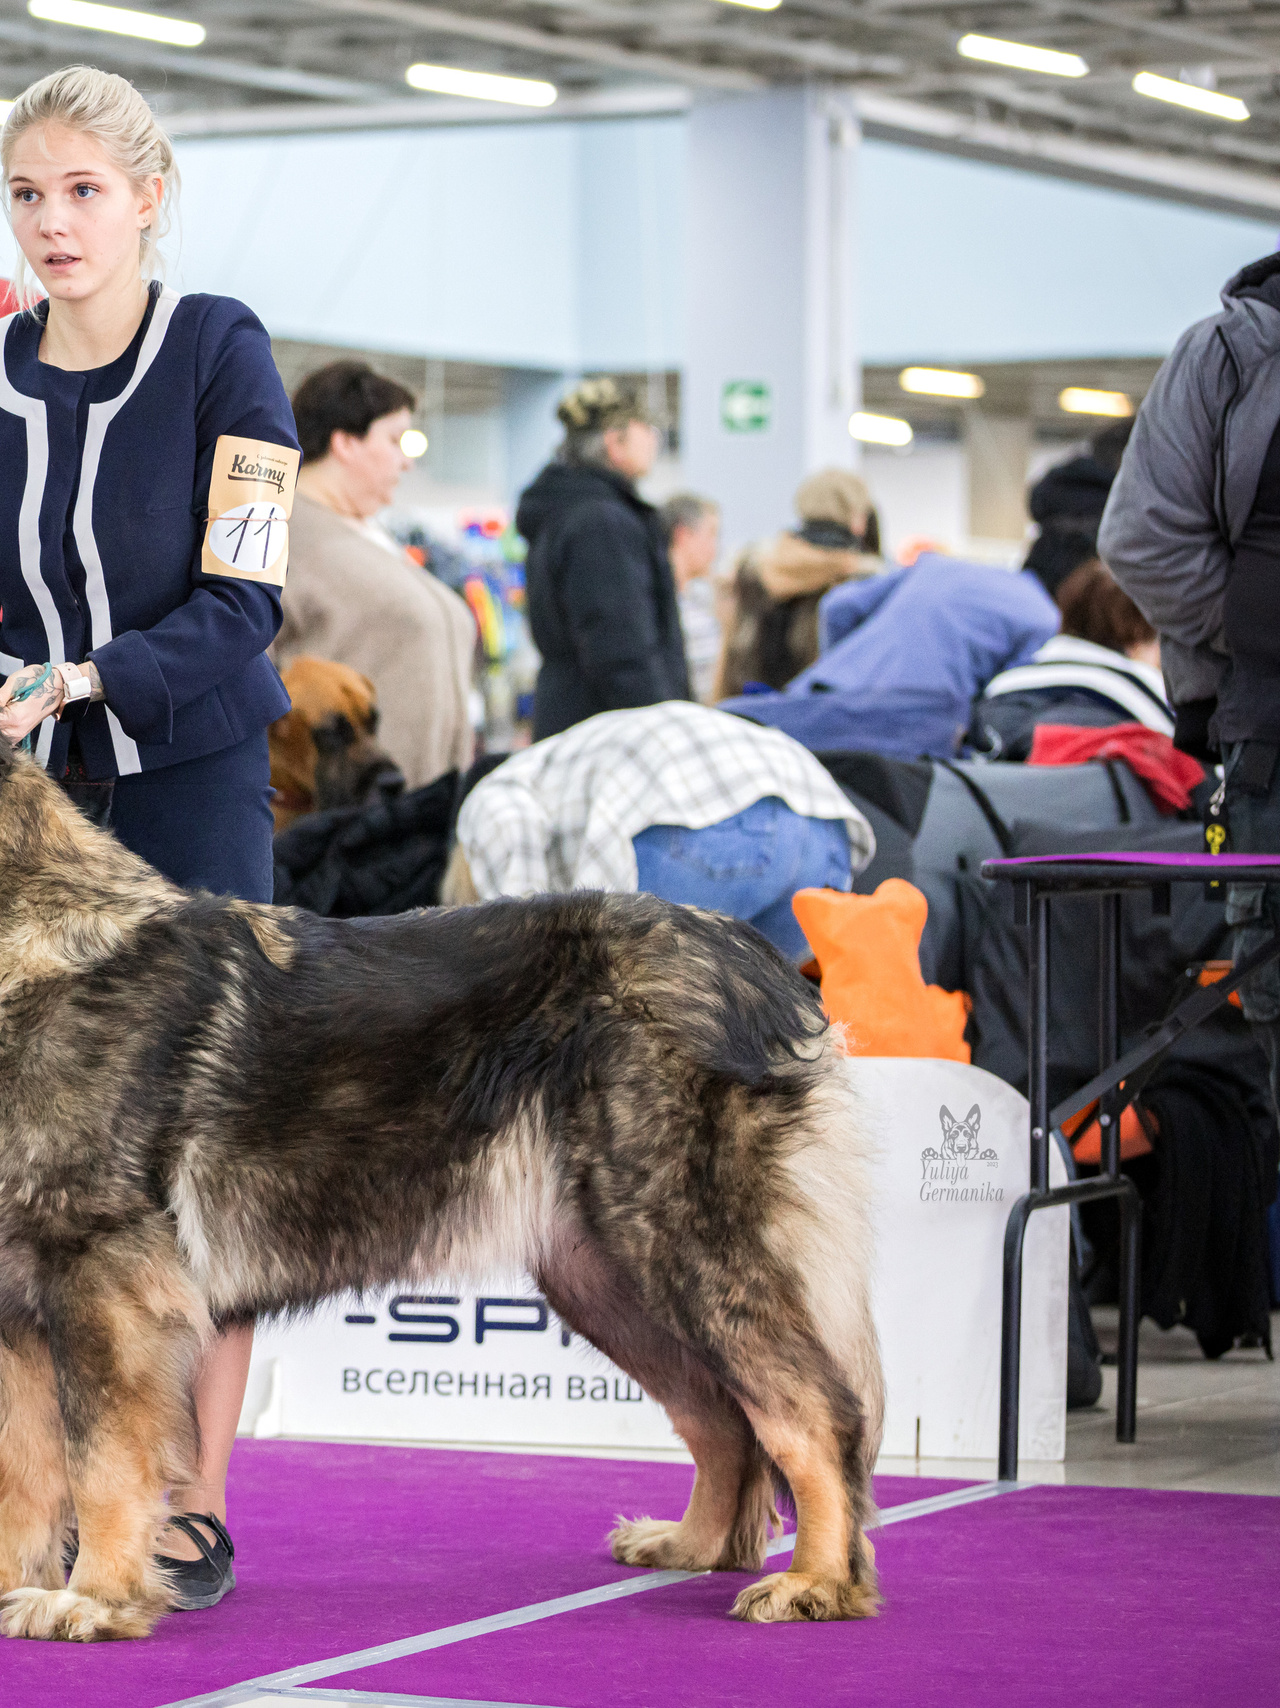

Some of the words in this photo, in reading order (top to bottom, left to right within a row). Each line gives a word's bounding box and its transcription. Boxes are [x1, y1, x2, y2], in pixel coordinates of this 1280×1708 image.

[230, 453, 286, 493] Karmy
[226, 507, 276, 569] 11
[342, 1366, 552, 1401] вселенная
